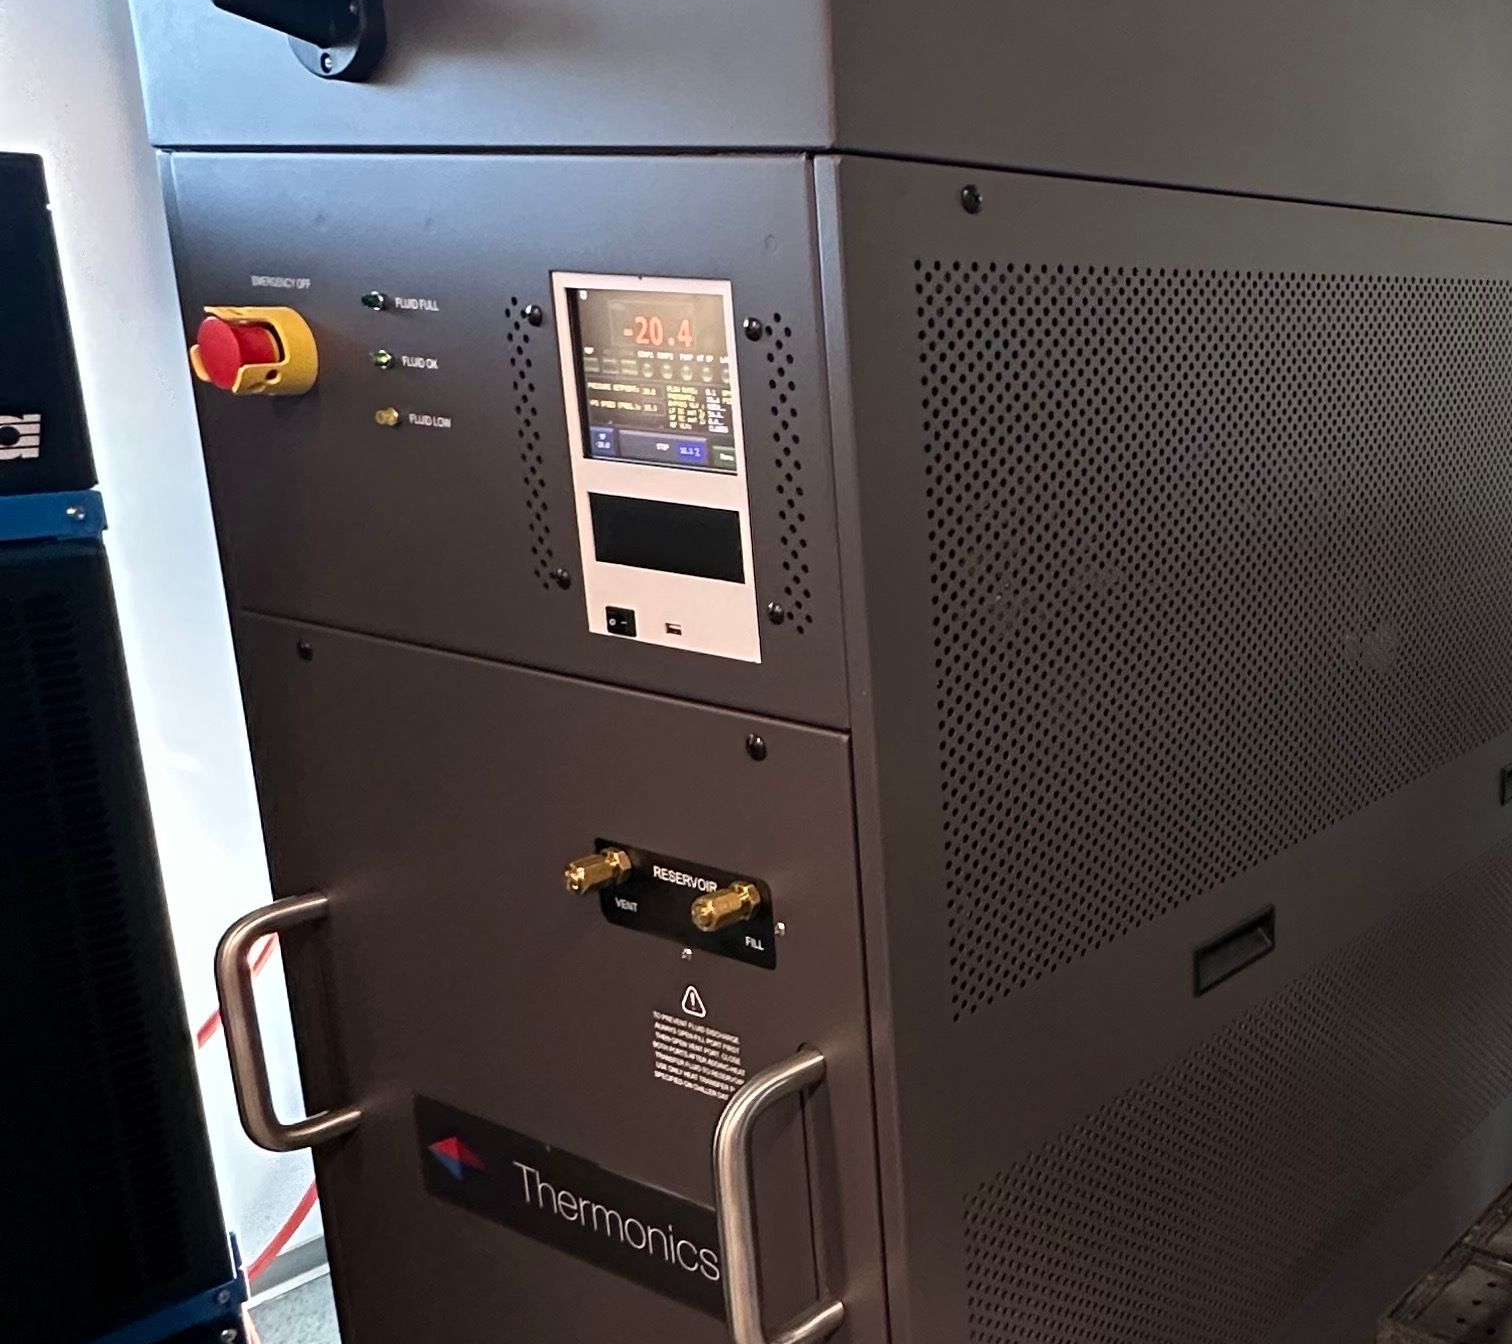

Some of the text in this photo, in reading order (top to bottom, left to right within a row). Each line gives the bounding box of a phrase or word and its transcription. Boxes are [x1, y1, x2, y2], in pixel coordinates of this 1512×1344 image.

[296, 278, 311, 290] OFF
[395, 297, 440, 312] FLUID FULL
[623, 316, 693, 347] -20.4
[402, 355, 439, 370] FLUID OK
[409, 413, 451, 428] FLUID LOW
[652, 864, 718, 893] RESERVOIR
[614, 896, 638, 913] VENT
[745, 935, 765, 952] FILL
[512, 1160, 720, 1281] Thermonics
